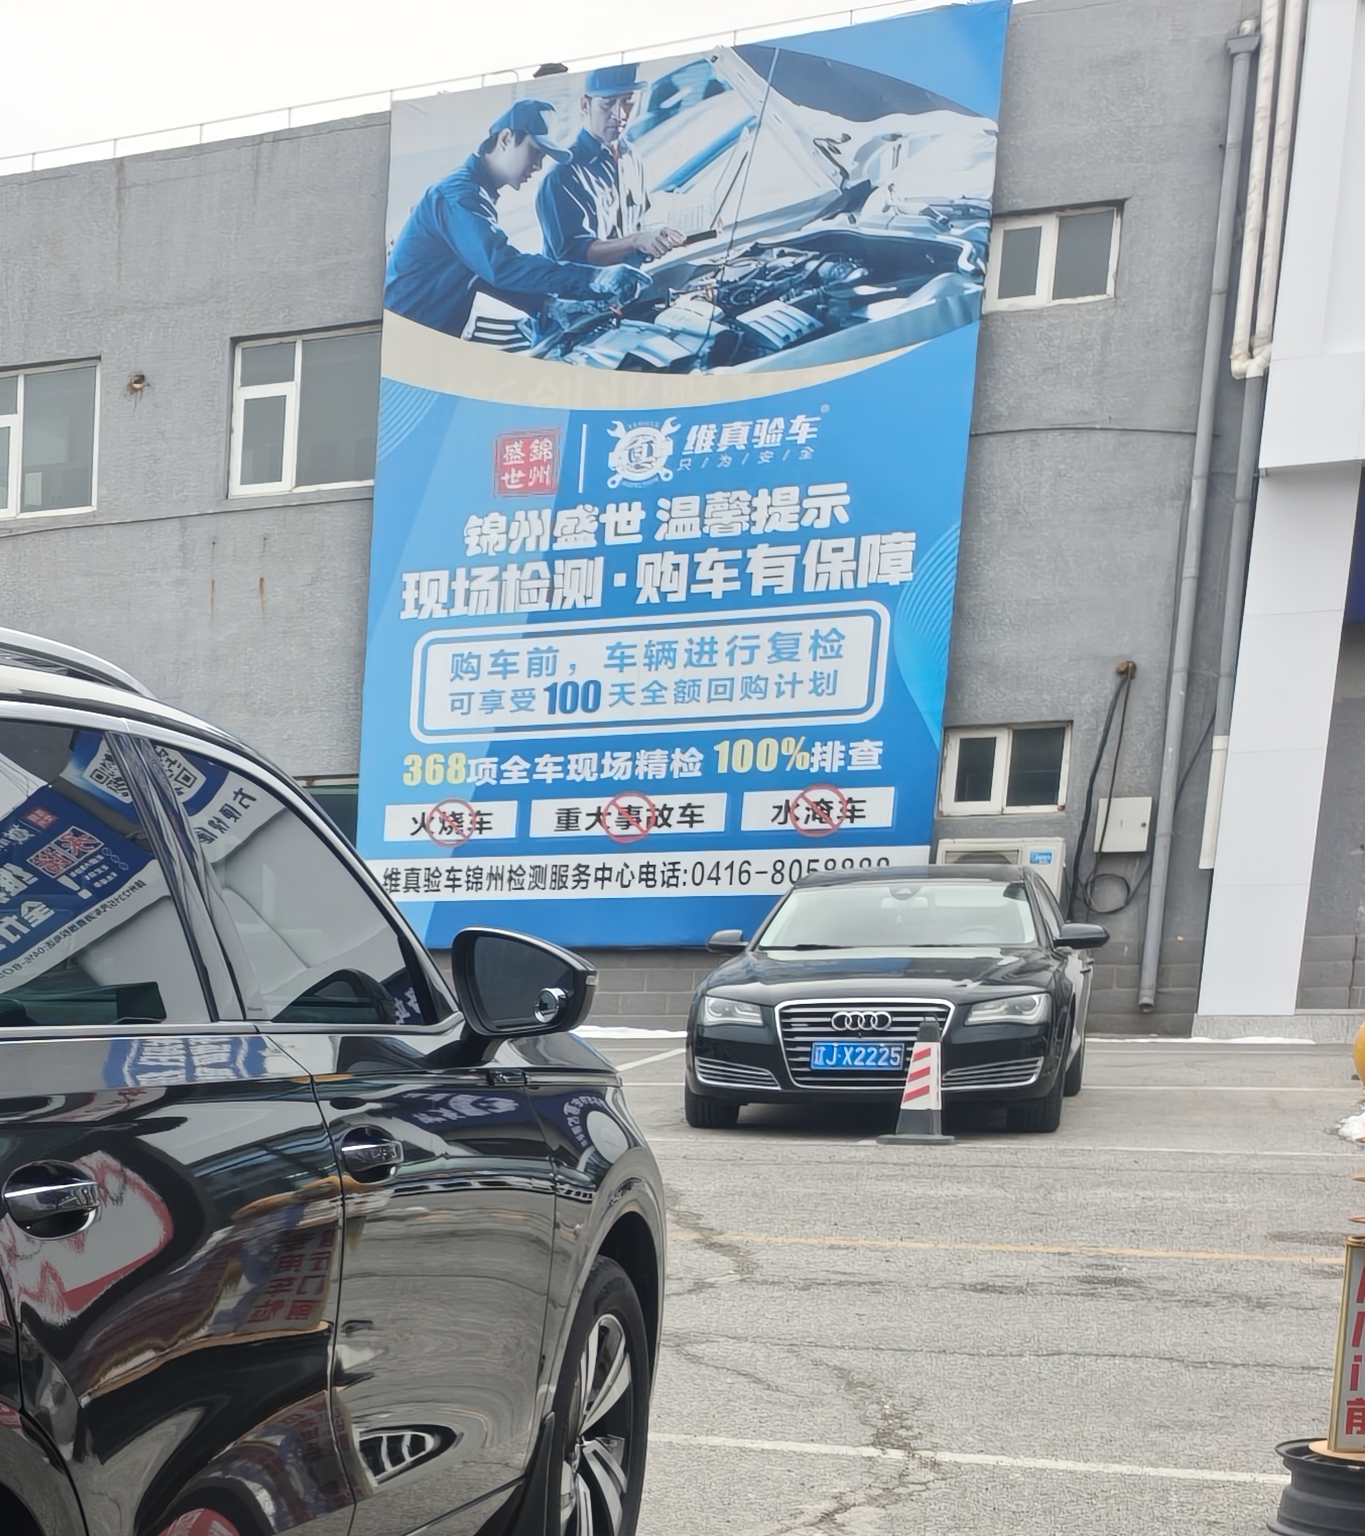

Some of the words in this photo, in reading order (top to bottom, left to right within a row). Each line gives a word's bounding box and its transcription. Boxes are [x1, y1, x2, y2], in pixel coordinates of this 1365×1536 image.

[681, 414, 822, 456] 维真验车
[463, 500, 647, 558] 锦州盛世
[655, 482, 851, 540] 温馨提示
[448, 668, 840, 717] 可享受100天全额回购计划
[402, 746, 705, 787] 368项全车现场精检
[713, 735, 884, 774] 100%排查
[409, 809, 494, 837] 火烧车
[553, 801, 706, 833] 重大事故车
